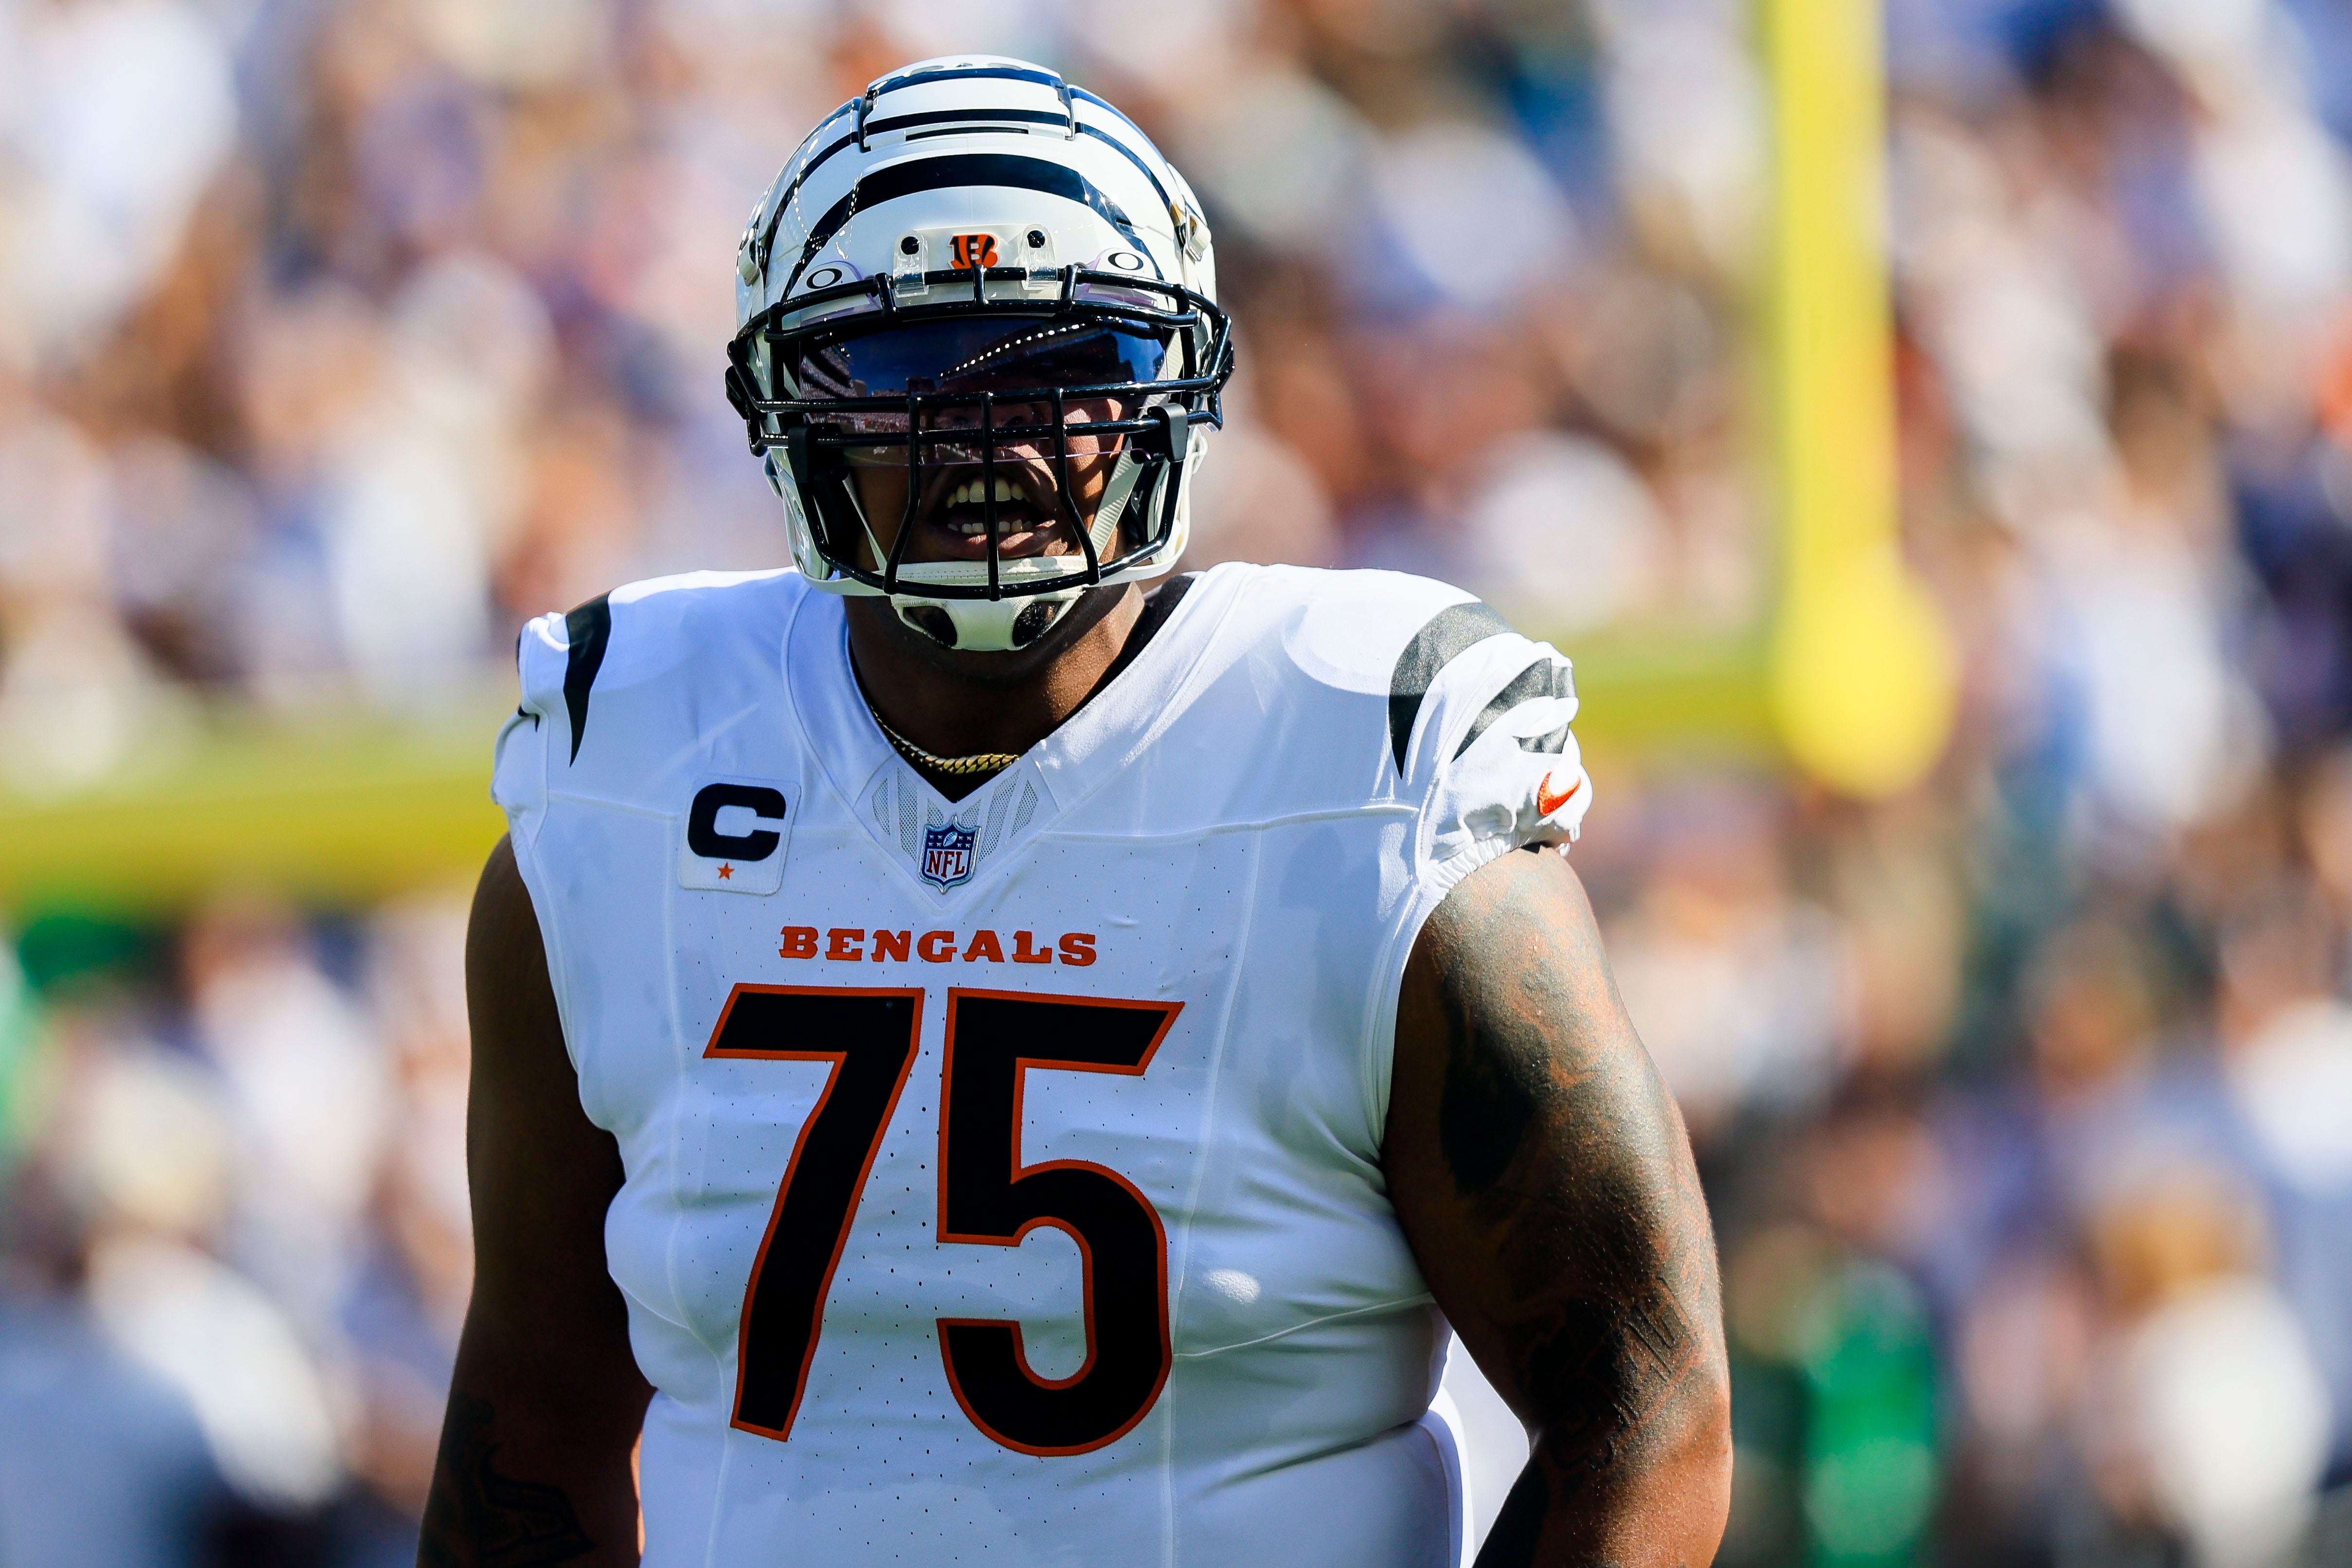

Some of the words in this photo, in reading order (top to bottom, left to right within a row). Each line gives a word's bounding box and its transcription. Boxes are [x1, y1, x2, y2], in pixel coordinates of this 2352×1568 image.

[687, 783, 786, 861] C
[926, 850, 965, 878] NFL
[779, 926, 1097, 966] BENGALS
[703, 982, 1185, 1459] 75
